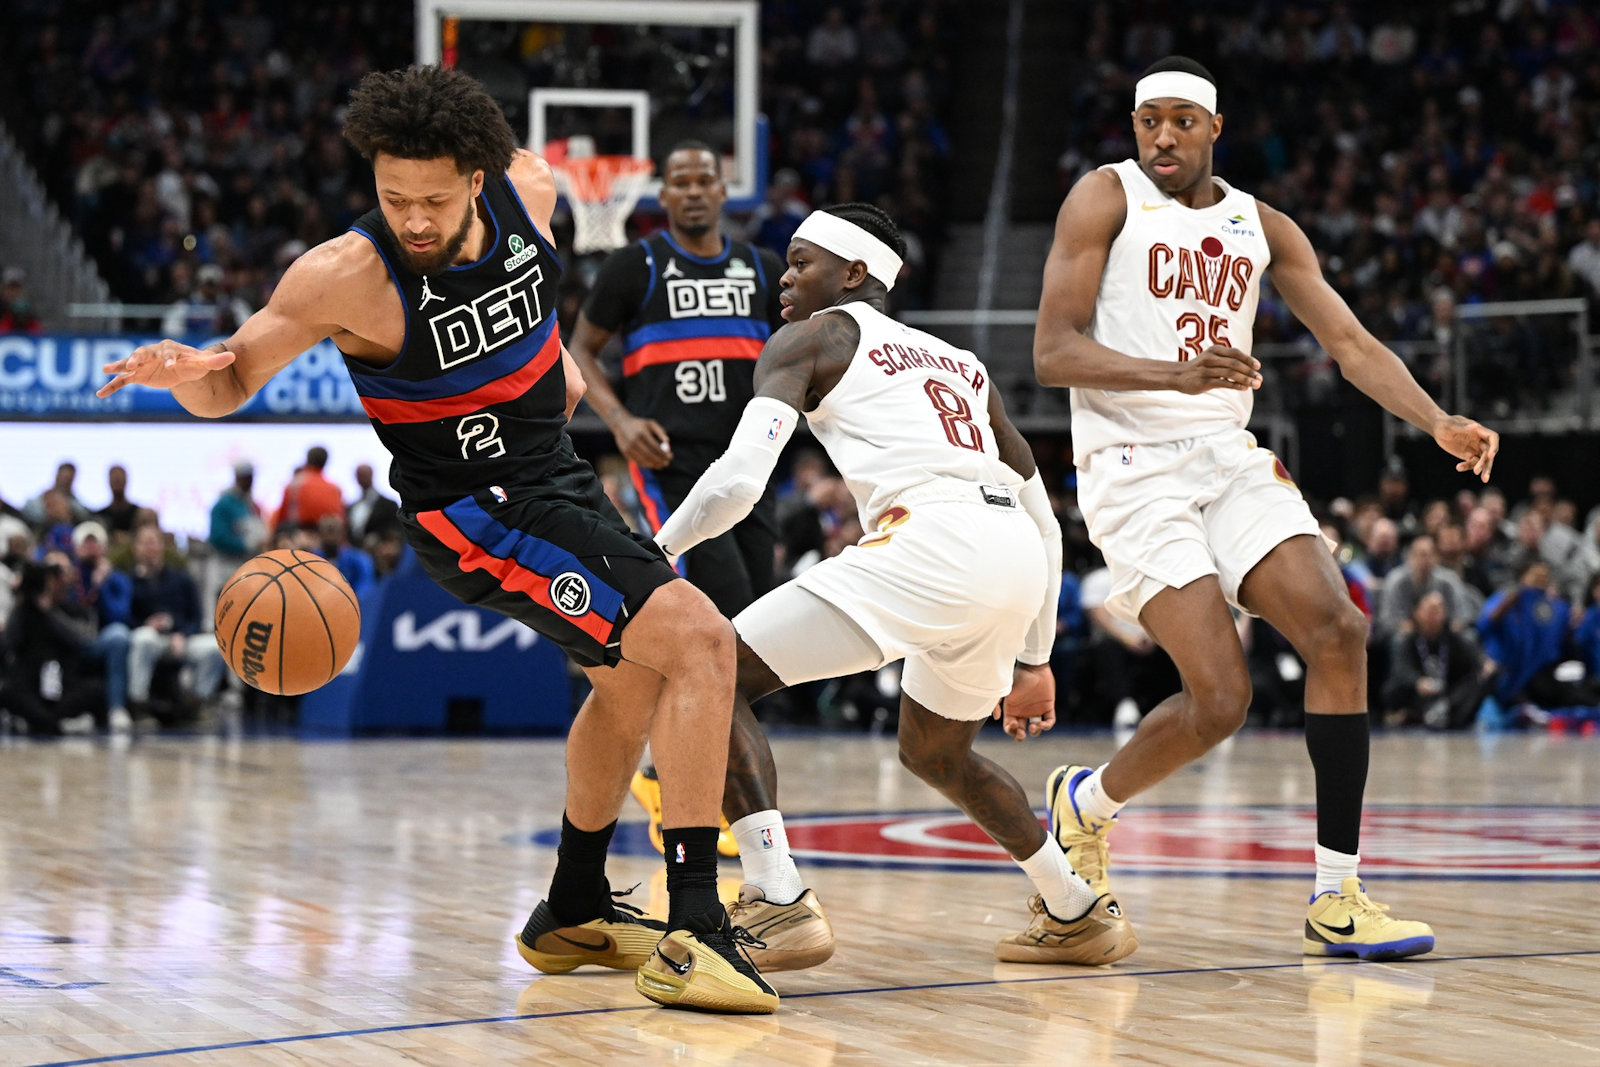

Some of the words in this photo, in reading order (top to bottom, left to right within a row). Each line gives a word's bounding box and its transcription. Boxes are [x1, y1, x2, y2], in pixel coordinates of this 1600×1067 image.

[1221, 225, 1255, 237] CLIFFS
[505, 245, 537, 270] StockX
[1148, 242, 1253, 312] CAVS
[428, 264, 544, 371] DET
[666, 278, 757, 320] DET
[1176, 312, 1233, 362] 35
[0, 336, 170, 393] CUR
[674, 359, 727, 404] 31
[868, 343, 985, 397] SCHRÖDER
[456, 412, 507, 460] 2
[923, 378, 985, 454] 8
[560, 579, 583, 609] DET
